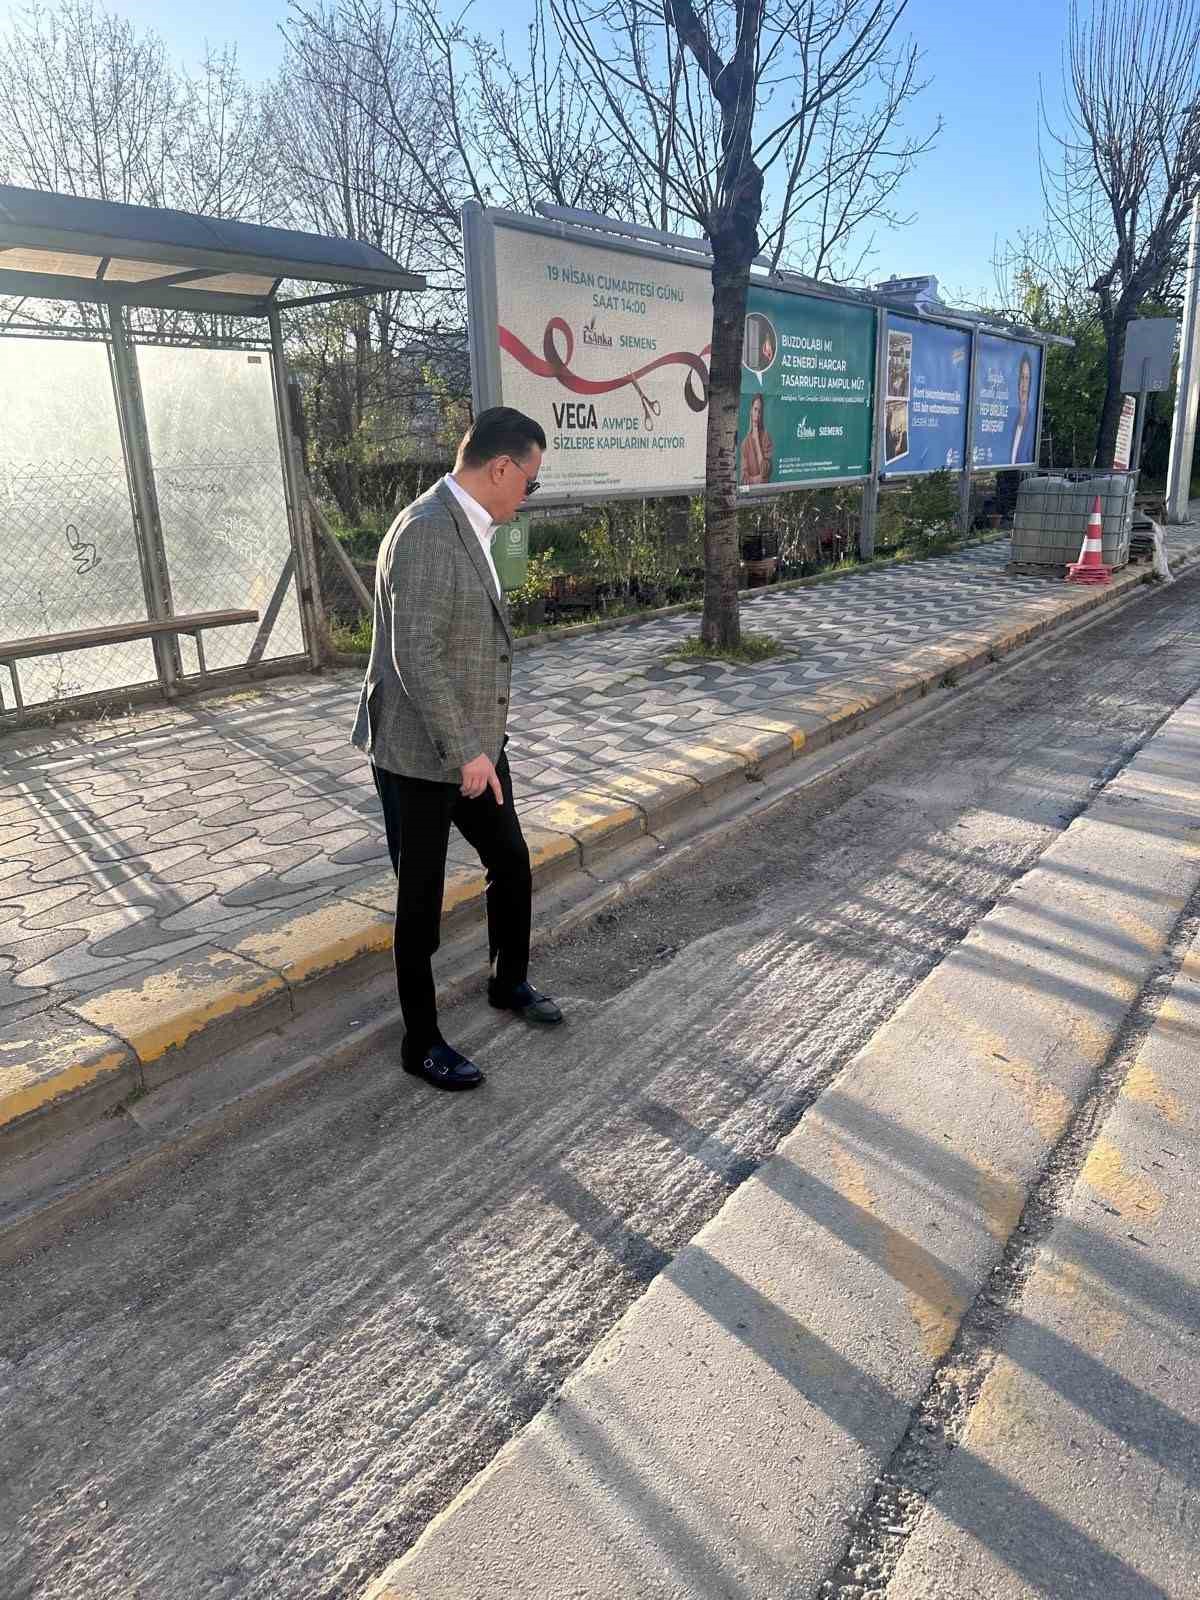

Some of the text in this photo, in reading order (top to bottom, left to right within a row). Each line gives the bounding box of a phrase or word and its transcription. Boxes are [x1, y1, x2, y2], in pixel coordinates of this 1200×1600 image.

[546, 265, 559, 281] 19
[562, 267, 595, 287] NİSAN
[597, 275, 655, 297] CUMARTESİ
[592, 294, 646, 314] SAAT 14:00
[619, 334, 657, 351] SIEMENS
[781, 335, 823, 350] BUZDOLABI
[781, 355, 847, 371] AZ ENERJİ HARCAR
[781, 374, 826, 389] TASARRUFLU
[827, 378, 850, 390] AMPUL
[552, 402, 640, 431] VEGA AVM'DE
[819, 426, 844, 437] SIEMENS
[553, 433, 685, 451] SİZLERE KAPILARINI AÇIYOR
